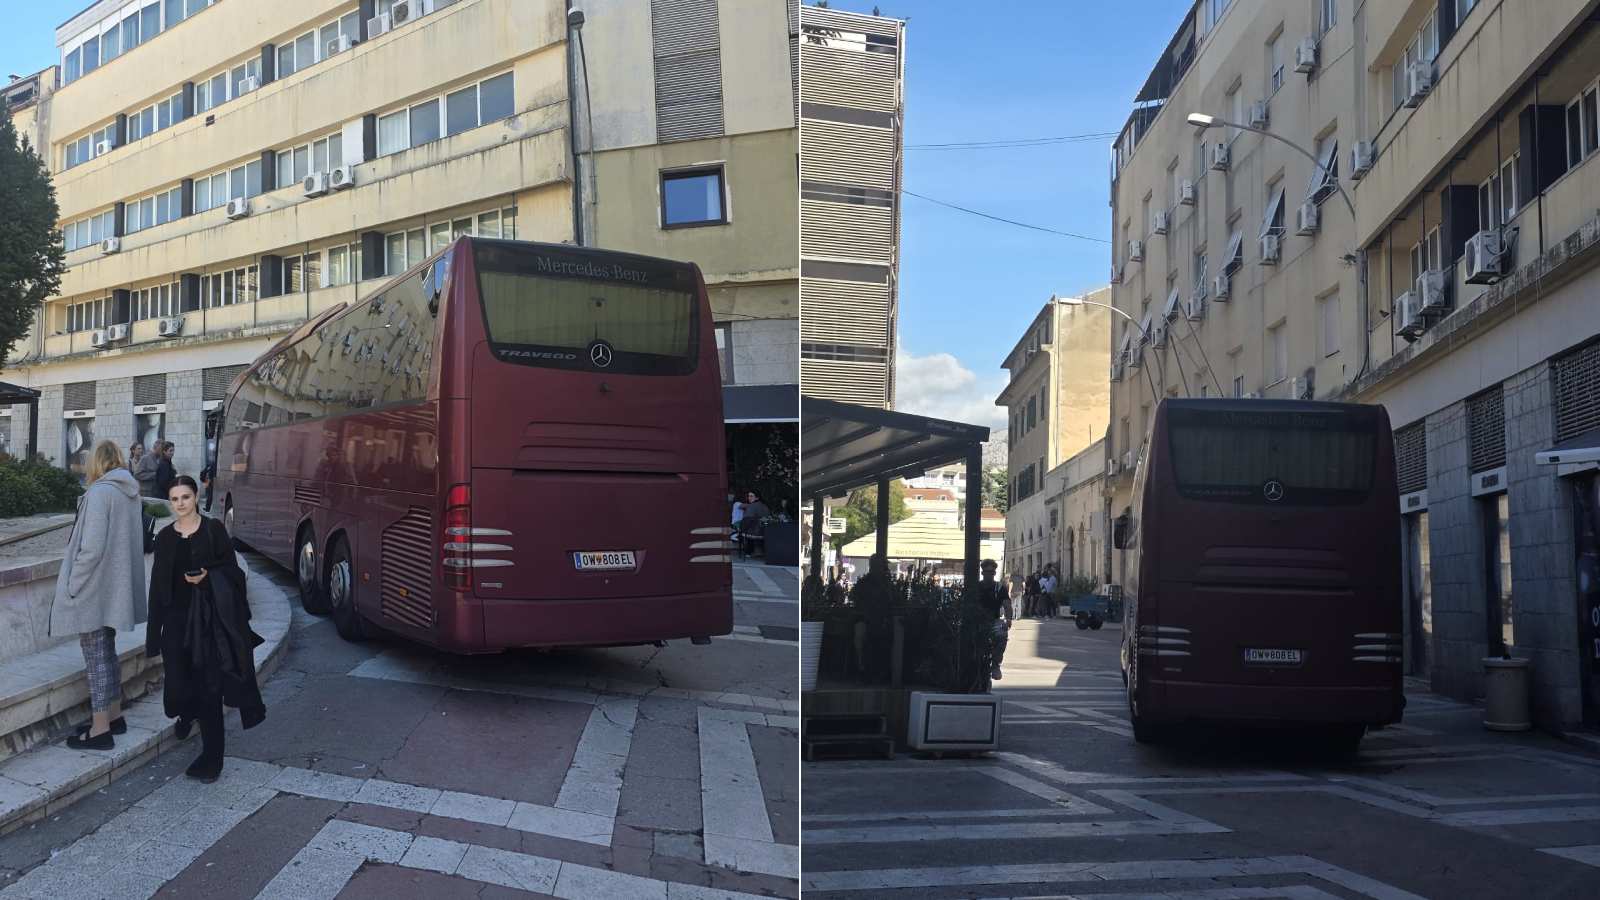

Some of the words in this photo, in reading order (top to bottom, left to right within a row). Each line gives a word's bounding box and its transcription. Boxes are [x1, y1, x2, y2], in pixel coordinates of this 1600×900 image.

[536, 255, 649, 282] Mercedes-Benz
[496, 349, 577, 360] TRAVEGO
[1592, 605, 1600, 627] O
